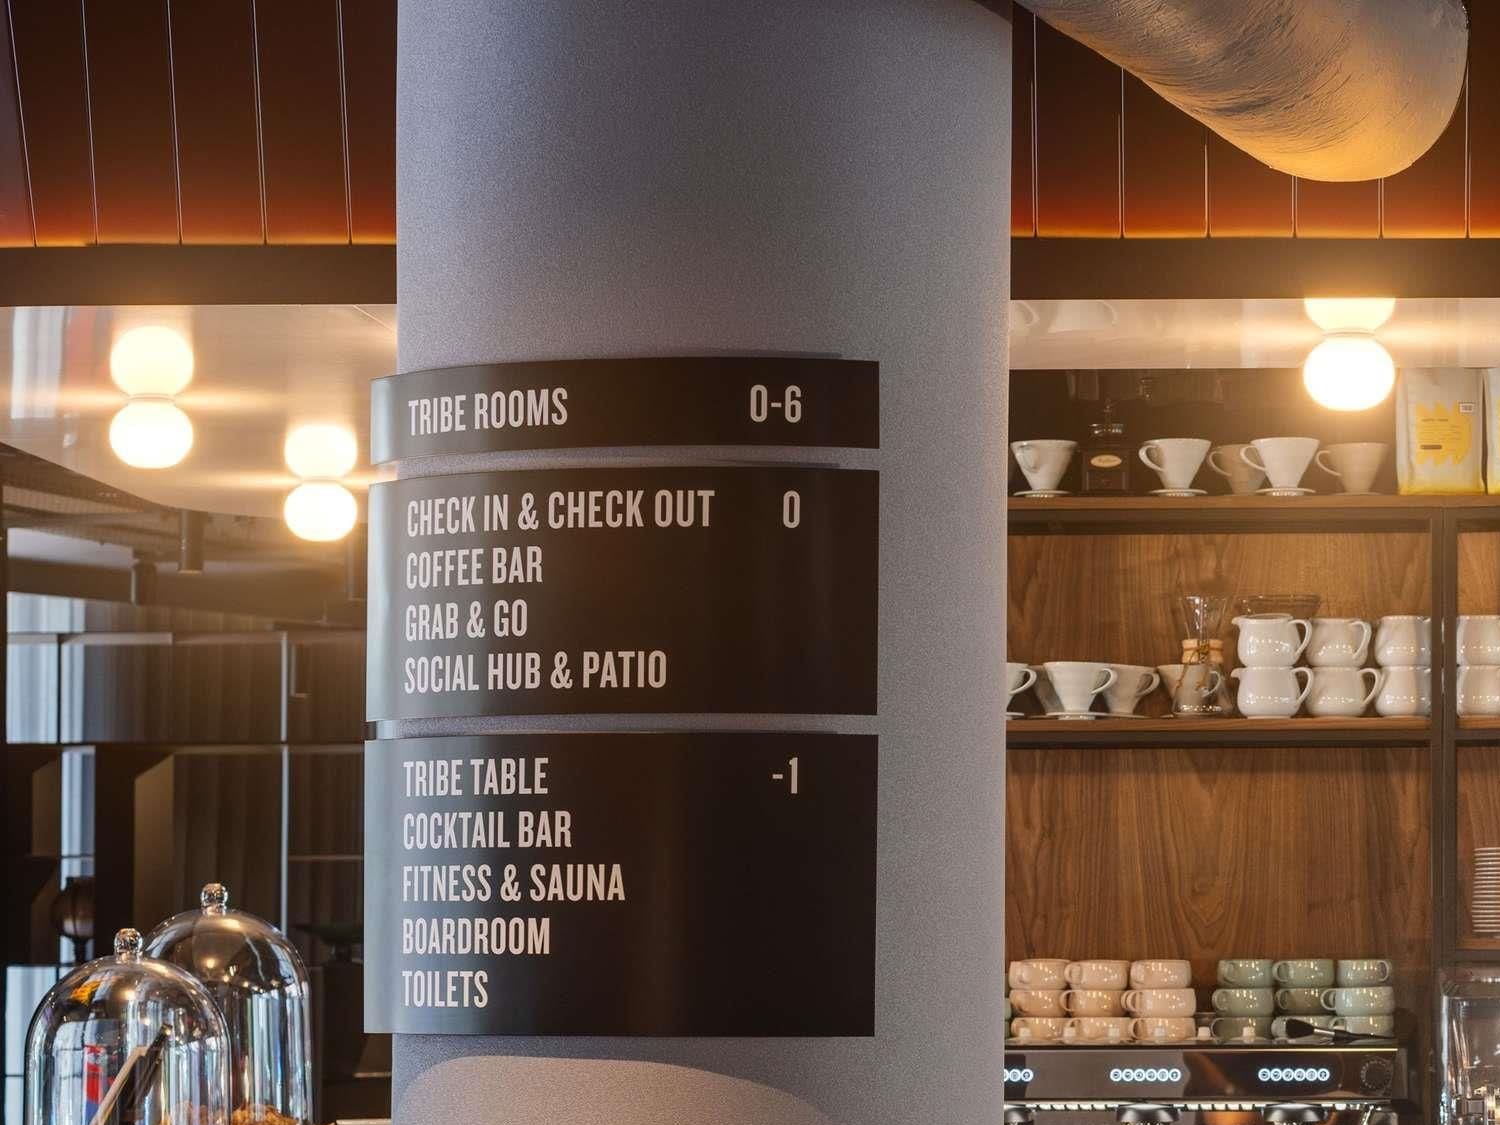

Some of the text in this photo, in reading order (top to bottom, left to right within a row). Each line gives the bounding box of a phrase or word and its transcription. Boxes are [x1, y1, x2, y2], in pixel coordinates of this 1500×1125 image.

[408, 388, 567, 436] TRIBE ROOMS
[751, 385, 801, 423] 0-6
[407, 490, 714, 537] CHECK IN & CHECK OUT
[783, 491, 800, 528] 0
[406, 546, 542, 589] COFFEE BAR
[406, 599, 527, 642] GRAB & GO
[404, 651, 666, 694] SOCIAL HUB & PATIO
[403, 758, 548, 797] TRIBE TABLE
[773, 757, 798, 793] -1
[403, 811, 571, 849] COCKTAIL BAR
[403, 864, 625, 902] FITNESS & SAUNA
[402, 918, 550, 955] BOARDROOM
[402, 971, 488, 1007] TOILETS
